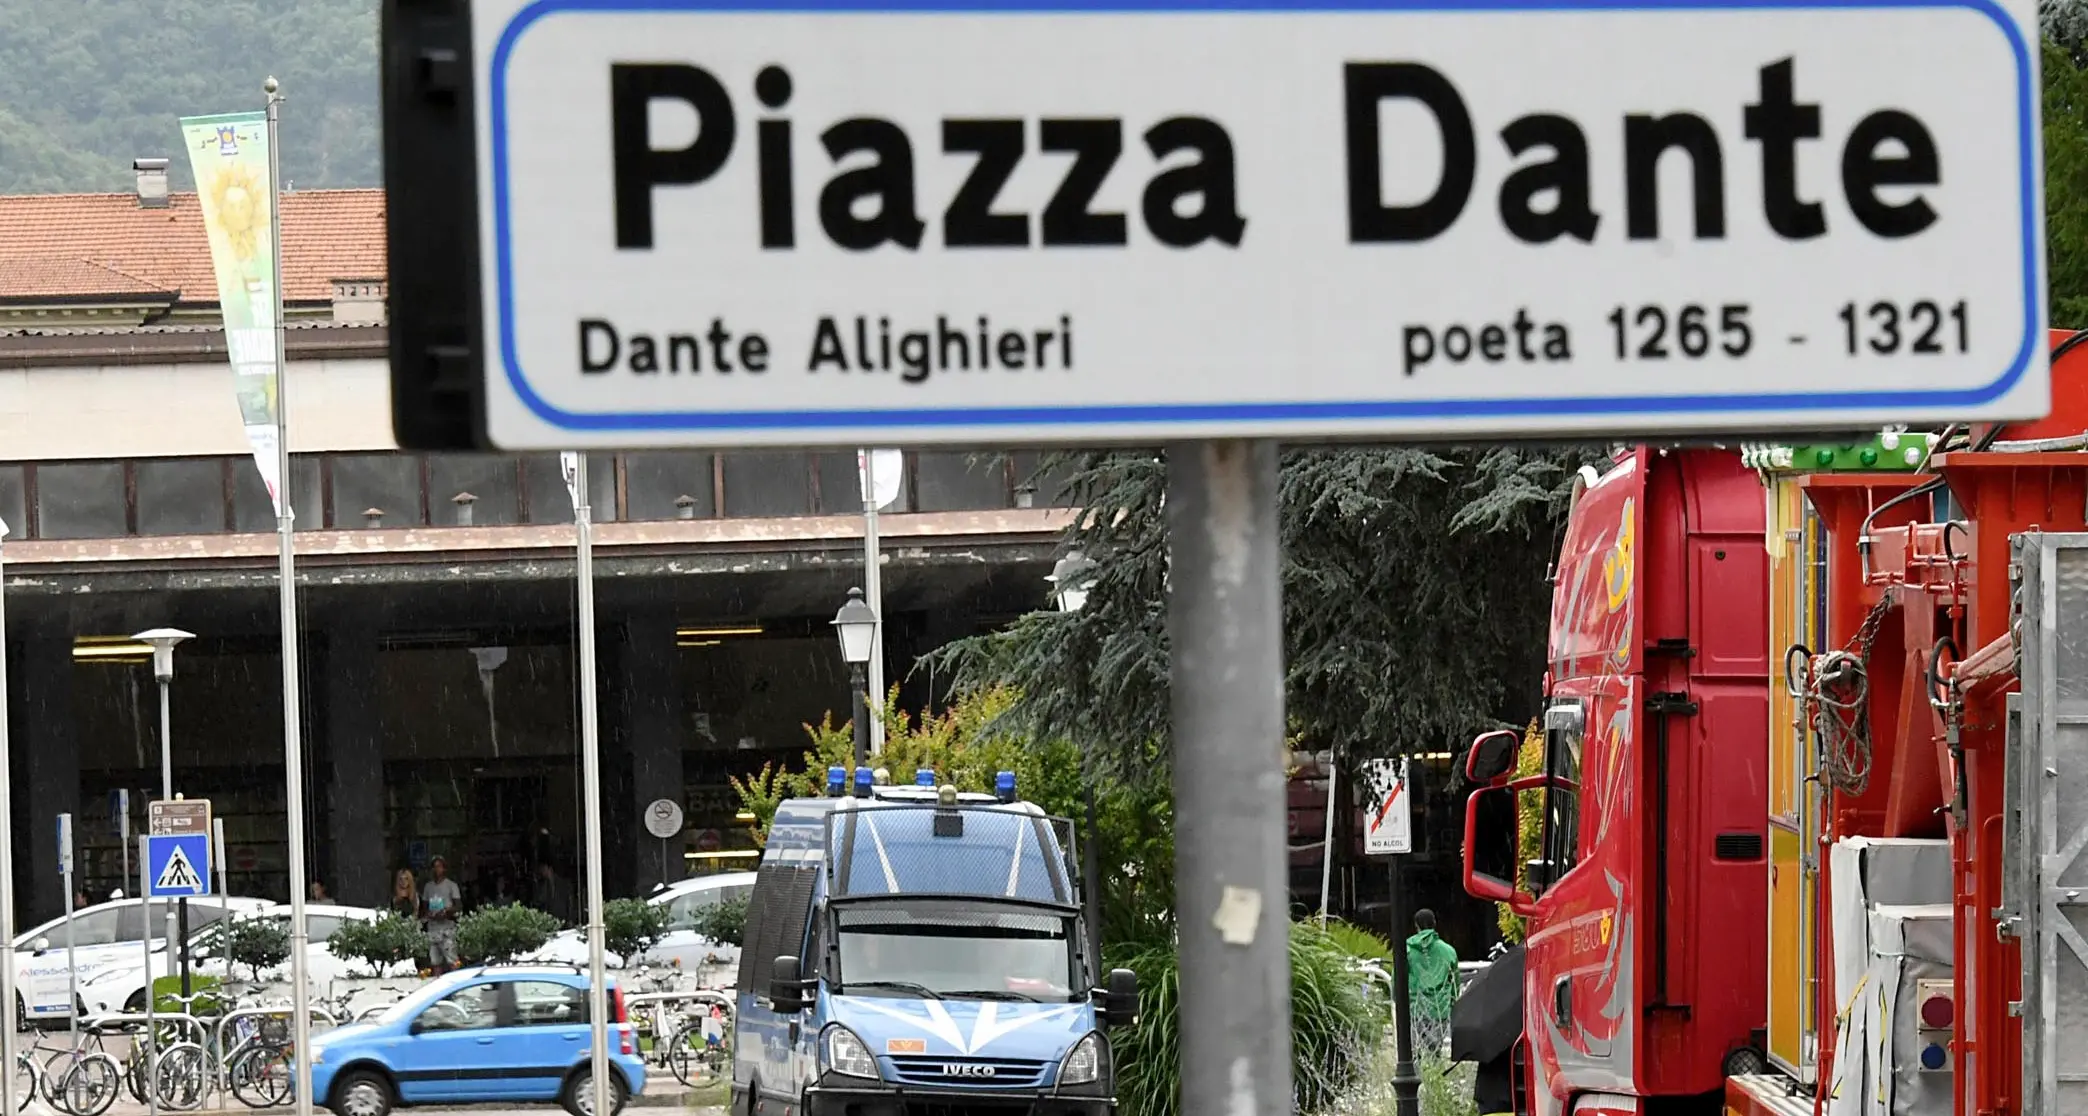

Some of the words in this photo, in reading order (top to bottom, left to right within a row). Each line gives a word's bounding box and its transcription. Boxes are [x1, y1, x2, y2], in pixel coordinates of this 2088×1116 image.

[609, 60, 1249, 253] Piazza
[1342, 55, 1943, 246] Dante
[577, 317, 771, 376] Dante
[807, 314, 1074, 386] Alighieri
[1402, 306, 1573, 377] poeta
[1607, 303, 1754, 361] 1265
[1838, 299, 1970, 357] 1321
[1371, 840, 1382, 848] NO
[943, 1063, 995, 1077] IVECO
